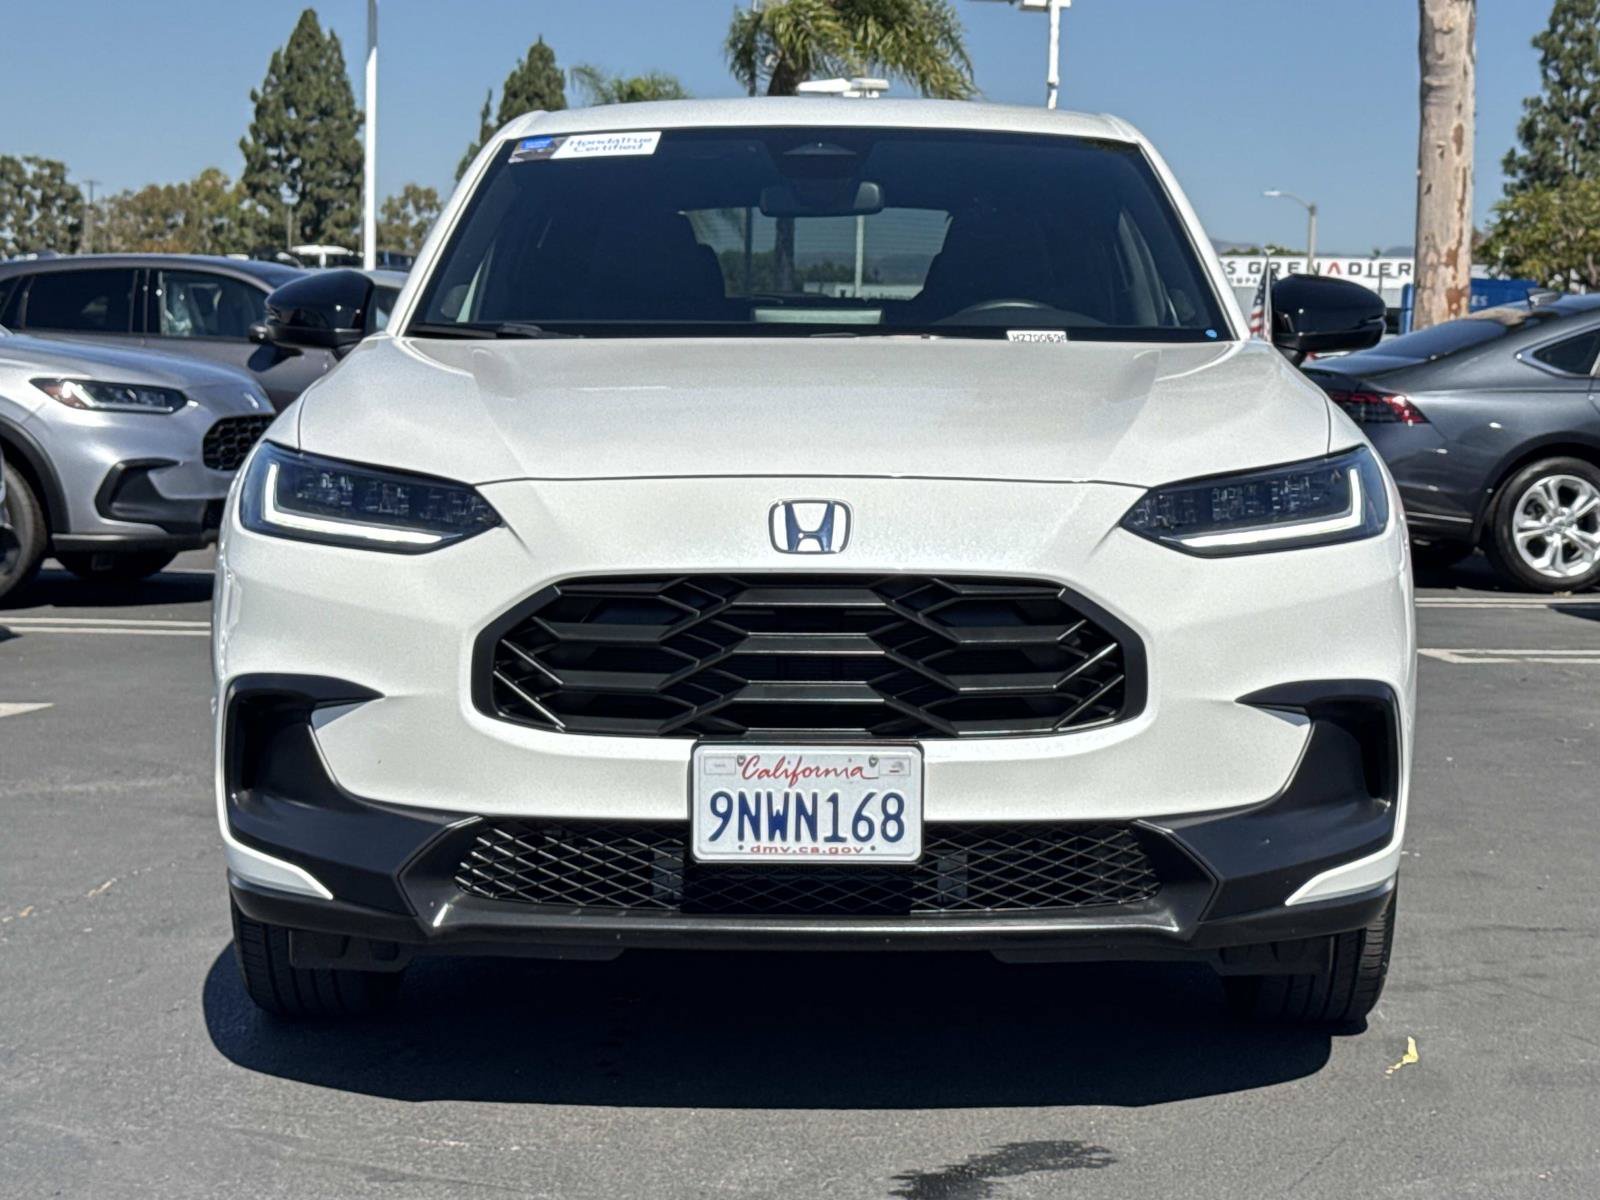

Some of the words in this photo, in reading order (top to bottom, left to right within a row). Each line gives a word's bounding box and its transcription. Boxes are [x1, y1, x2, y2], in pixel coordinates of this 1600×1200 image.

[574, 143, 643, 153] Certified
[1248, 261, 1412, 276] GRENADIER
[741, 755, 880, 788] California
[708, 791, 905, 843] 9NWN168
[750, 845, 864, 855] dmv.ca.gov
